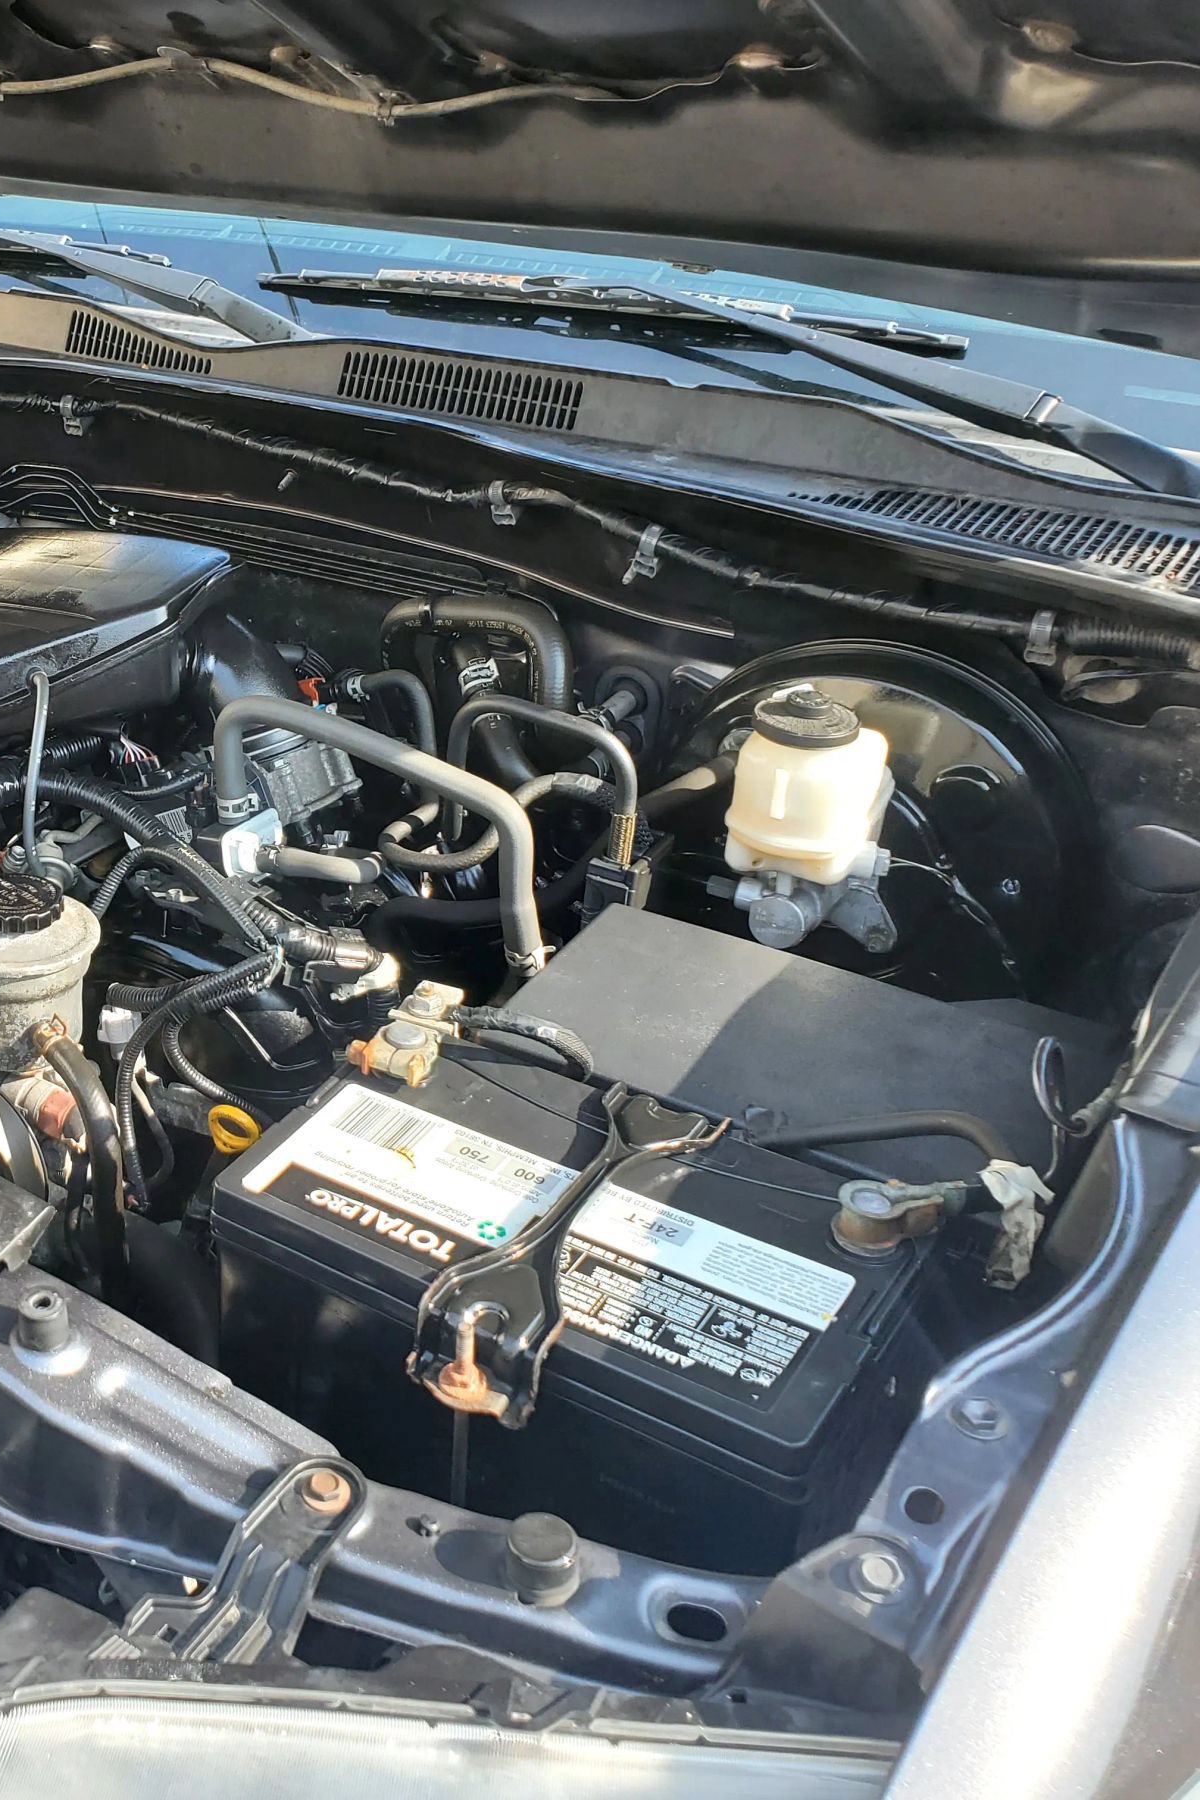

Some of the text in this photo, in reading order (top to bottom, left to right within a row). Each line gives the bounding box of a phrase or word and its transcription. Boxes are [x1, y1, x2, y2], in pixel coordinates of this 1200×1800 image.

[457, 1144, 491, 1164] 750
[512, 1166, 547, 1186] 600
[305, 1187, 456, 1263] TOTALPRO
[622, 1210, 678, 1238] 24F-T
[630, 1323, 655, 1339] NO
